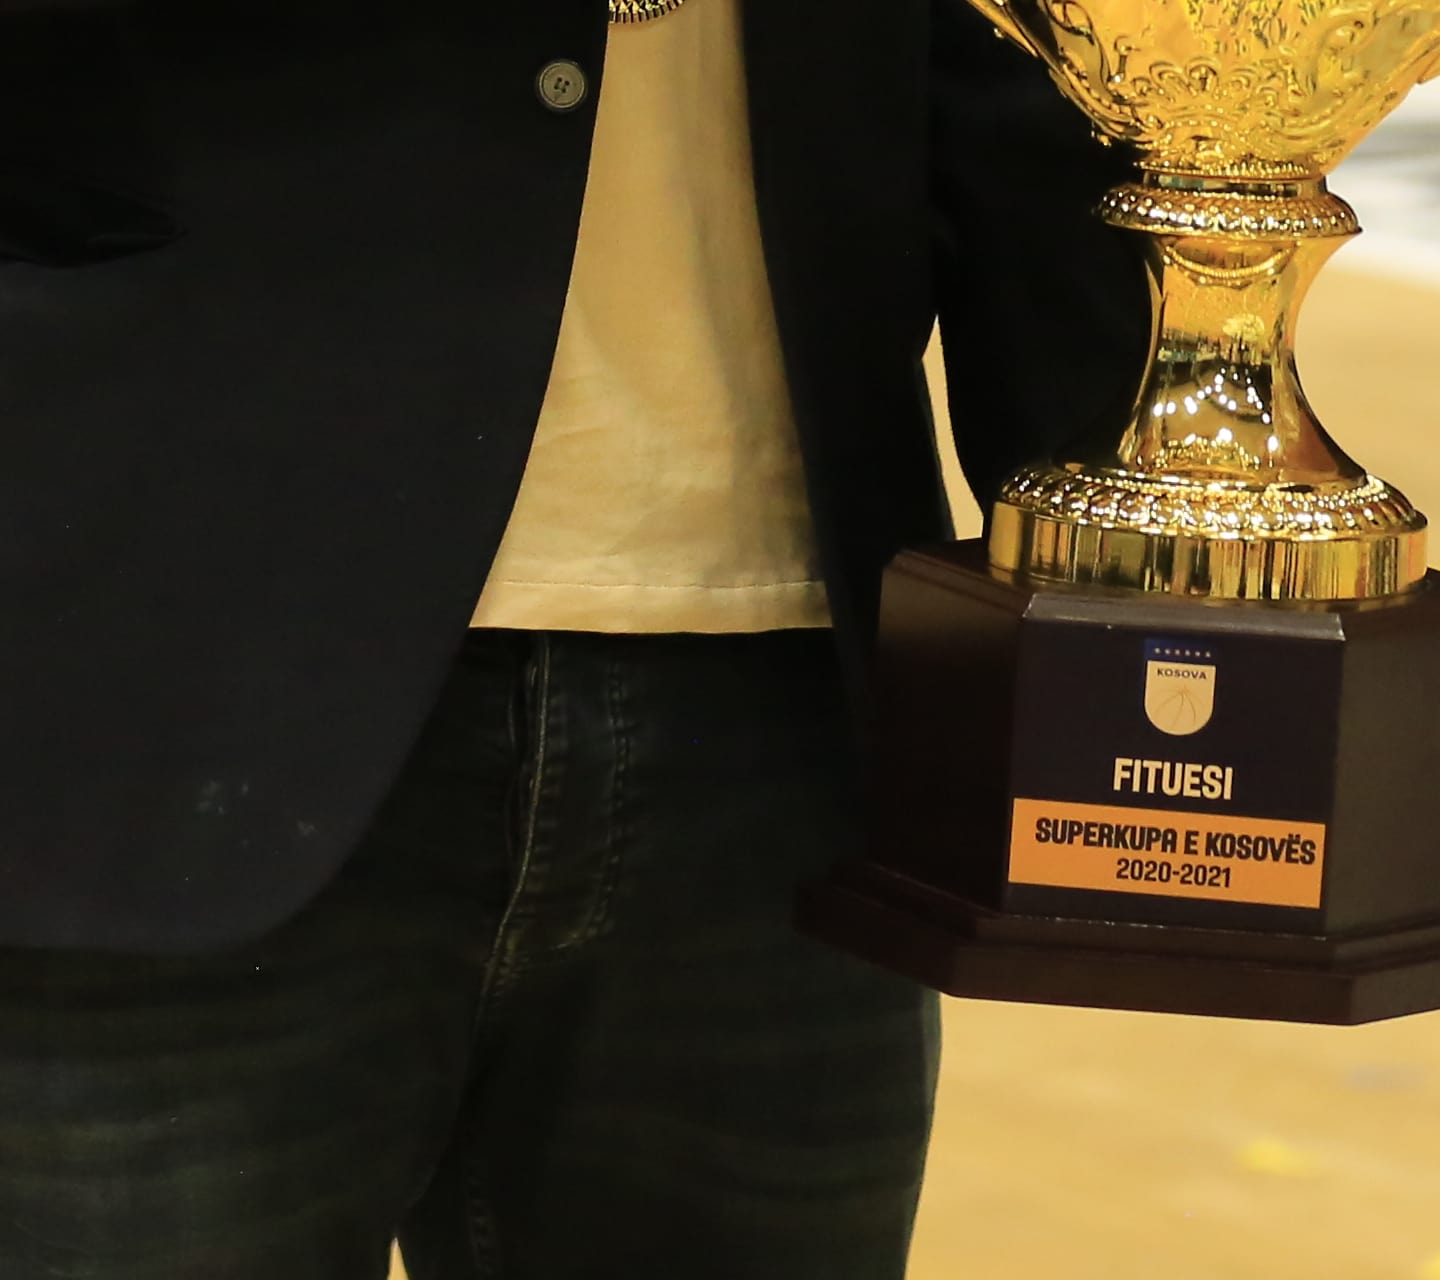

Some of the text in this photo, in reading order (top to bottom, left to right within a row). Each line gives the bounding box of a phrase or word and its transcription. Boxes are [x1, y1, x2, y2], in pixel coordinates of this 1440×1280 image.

[1156, 667, 1208, 681] KOSOVA
[1113, 757, 1234, 801] FITUESI
[1035, 817, 1317, 866] SUPERKUPA E KOSOVËS
[1116, 857, 1232, 889] 2020-2021
